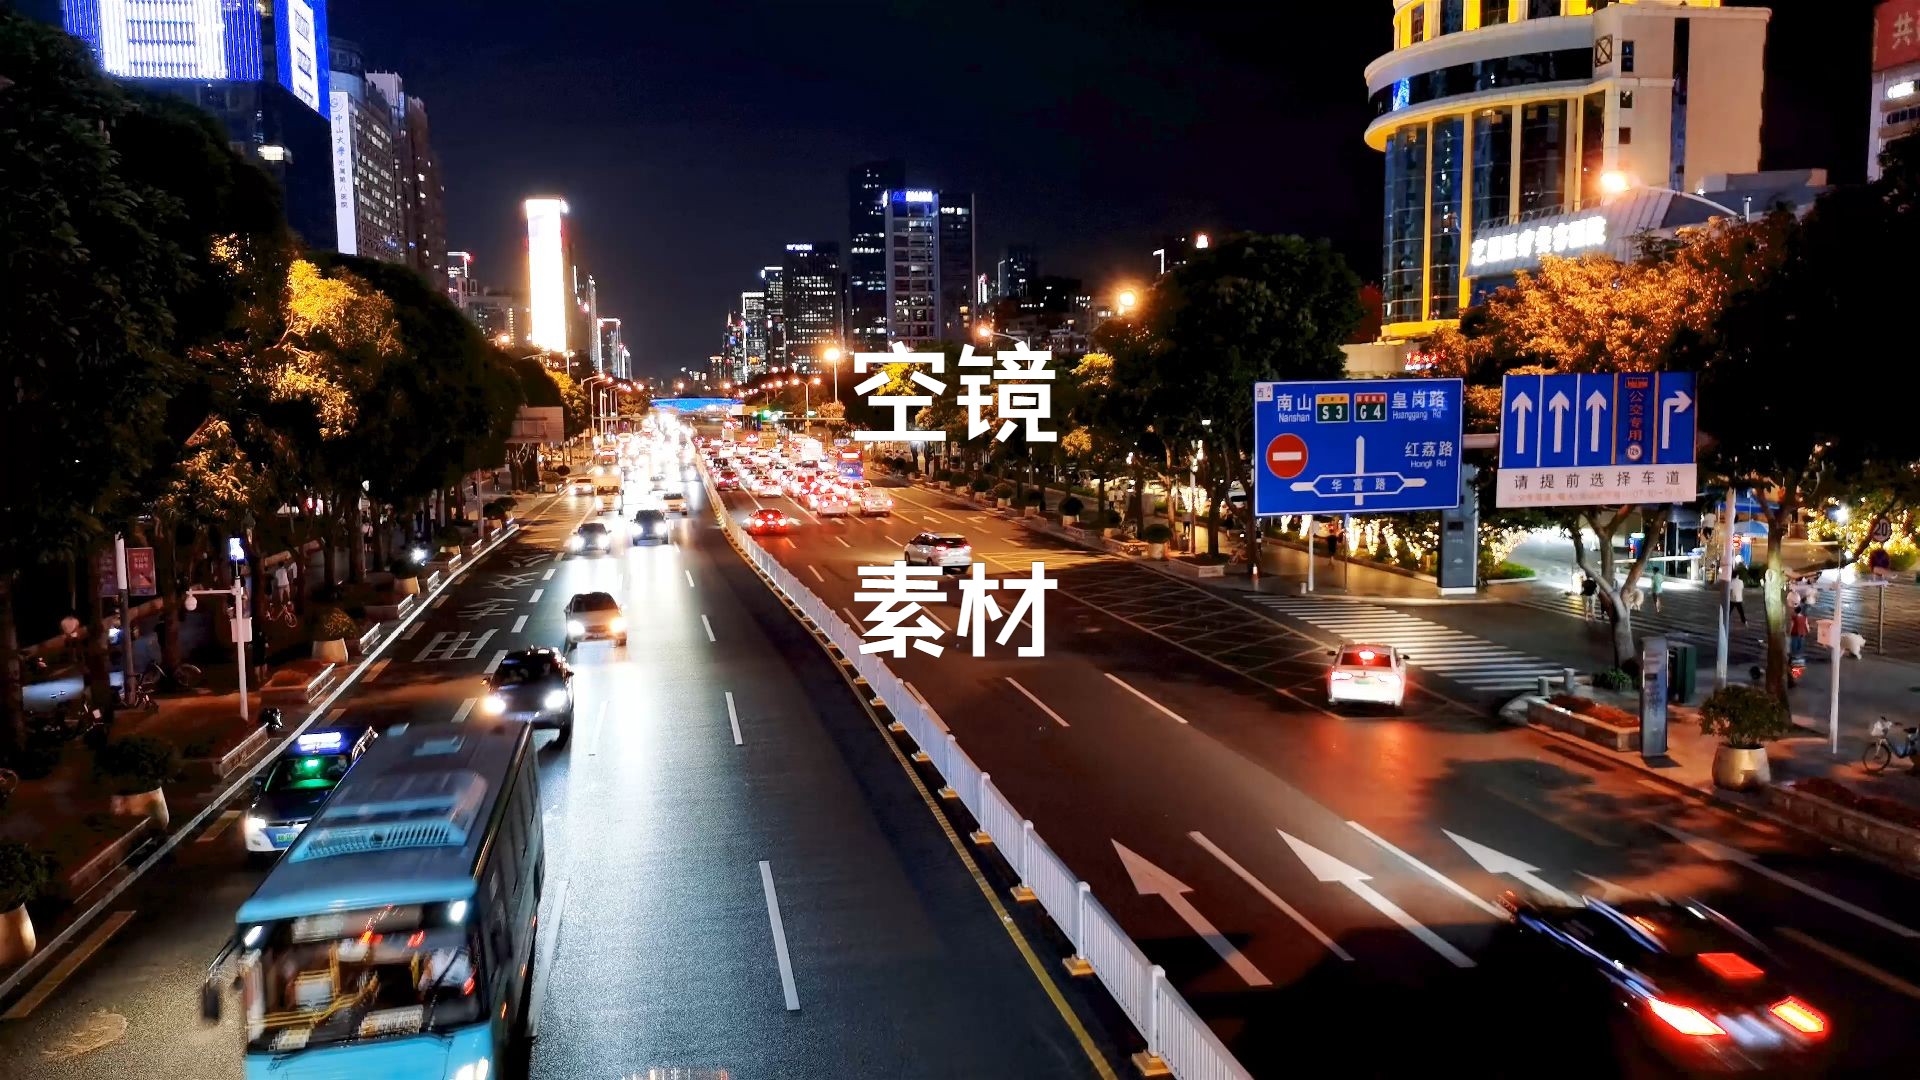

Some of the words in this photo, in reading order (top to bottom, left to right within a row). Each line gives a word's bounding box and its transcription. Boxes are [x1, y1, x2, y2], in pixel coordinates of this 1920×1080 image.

[1277, 393, 1312, 411] 南山
[1391, 390, 1445, 409] 皇岗路
[1279, 412, 1310, 423] Nanshan
[1393, 410, 1427, 421] Huanggang
[1433, 409, 1441, 418] Rd
[1629, 390, 1644, 441] 公交专用
[1405, 441, 1453, 457] 红荔路
[1411, 460, 1432, 469] Hongli
[1437, 459, 1446, 467] Rd
[1331, 478, 1386, 492] 华富路
[1514, 470, 1681, 489] 请提前选择车道
